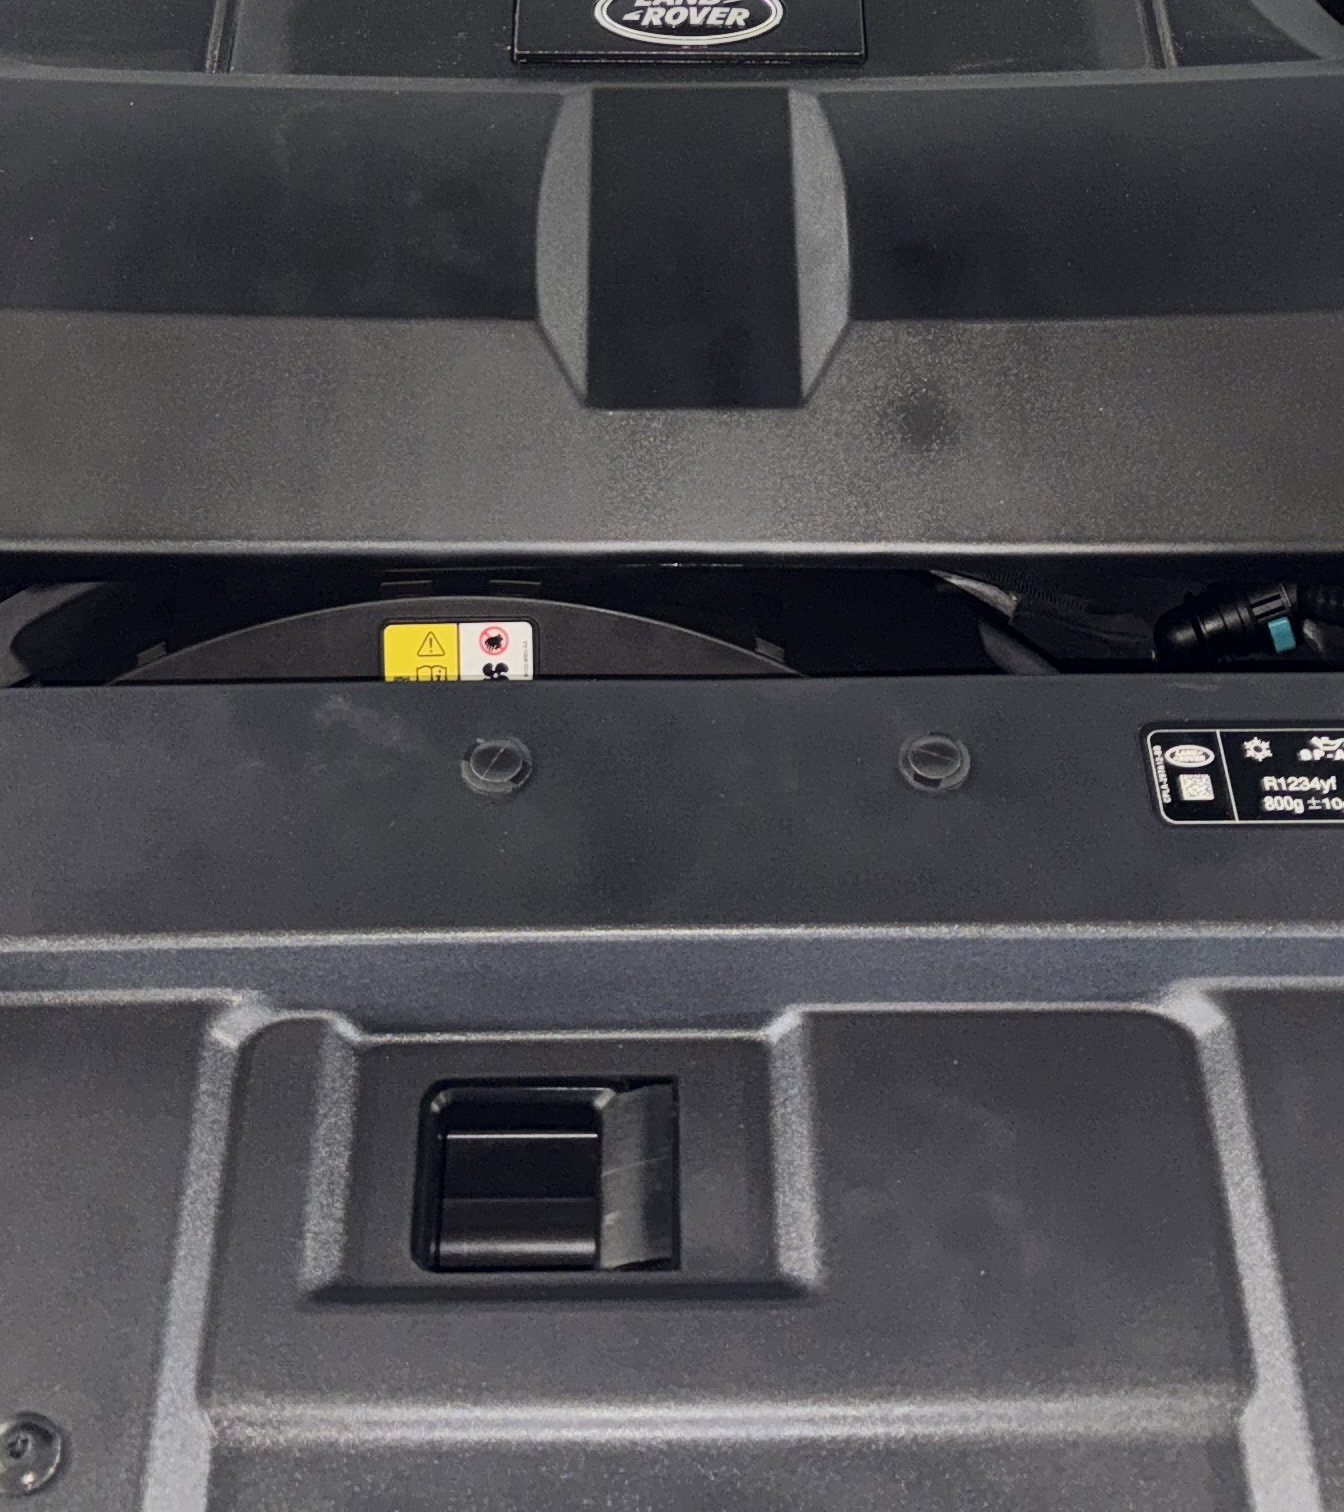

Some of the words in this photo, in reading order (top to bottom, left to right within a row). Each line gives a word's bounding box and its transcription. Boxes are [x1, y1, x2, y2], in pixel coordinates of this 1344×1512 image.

[646, 6, 751, 28] ROVER
[1262, 775, 1338, 794] R1234yf
[1263, 795, 1305, 814] 800g
